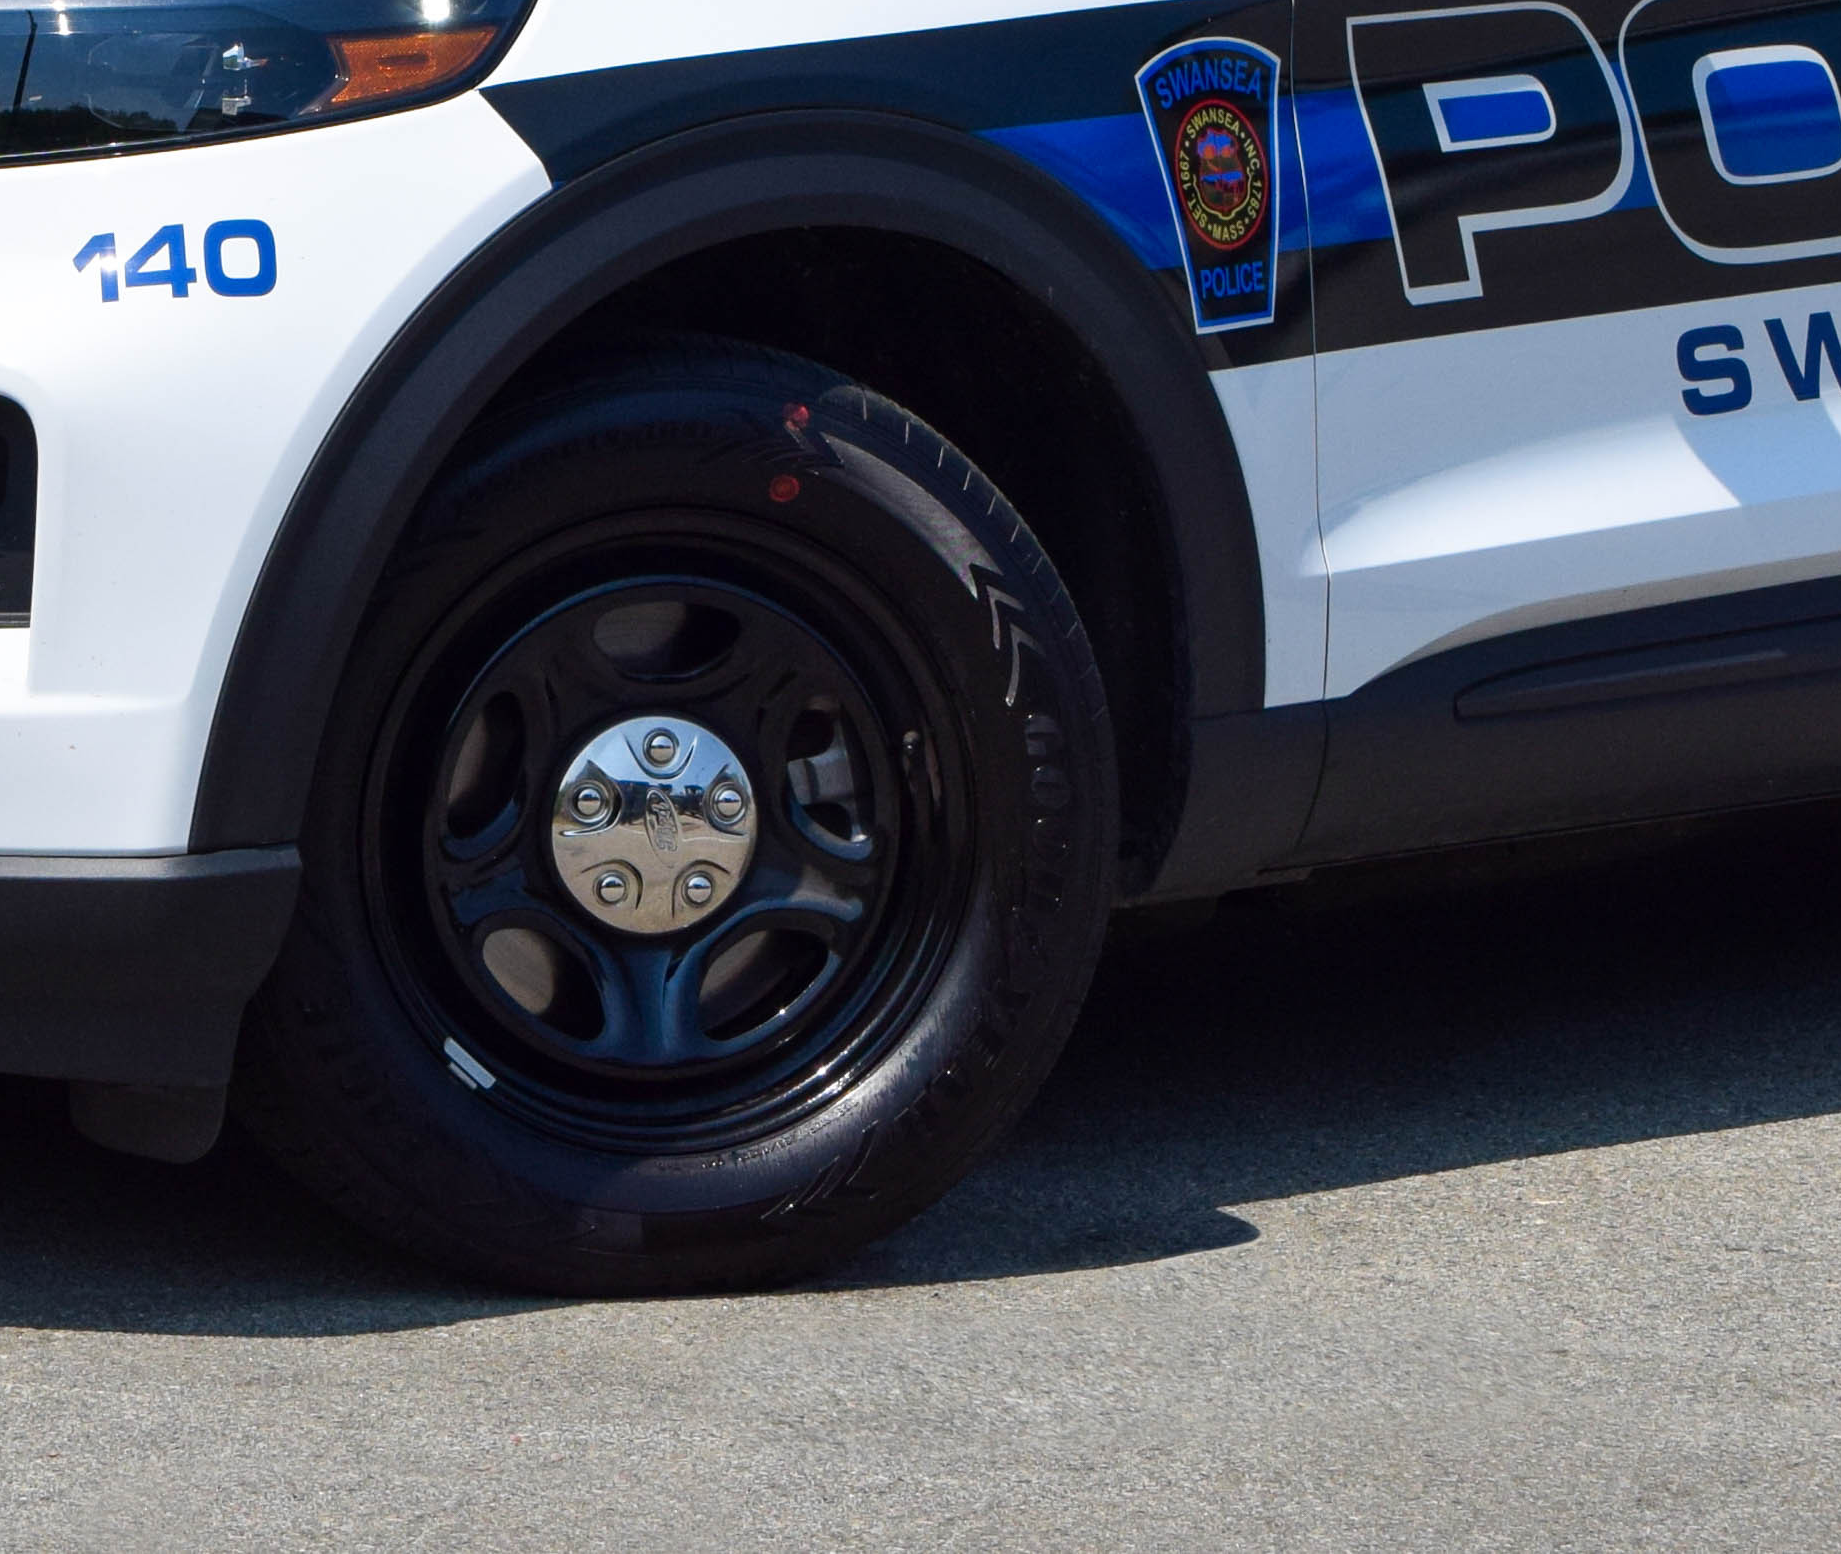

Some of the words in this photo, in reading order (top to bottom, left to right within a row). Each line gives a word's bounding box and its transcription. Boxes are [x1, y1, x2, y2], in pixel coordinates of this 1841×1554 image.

[1155, 57, 1262, 109] SWANSEA
[1186, 107, 1240, 140] SWANSEA
[1179, 150, 1191, 190] 1667
[72, 218, 276, 302] 140
[1200, 261, 1265, 299] POLICE
